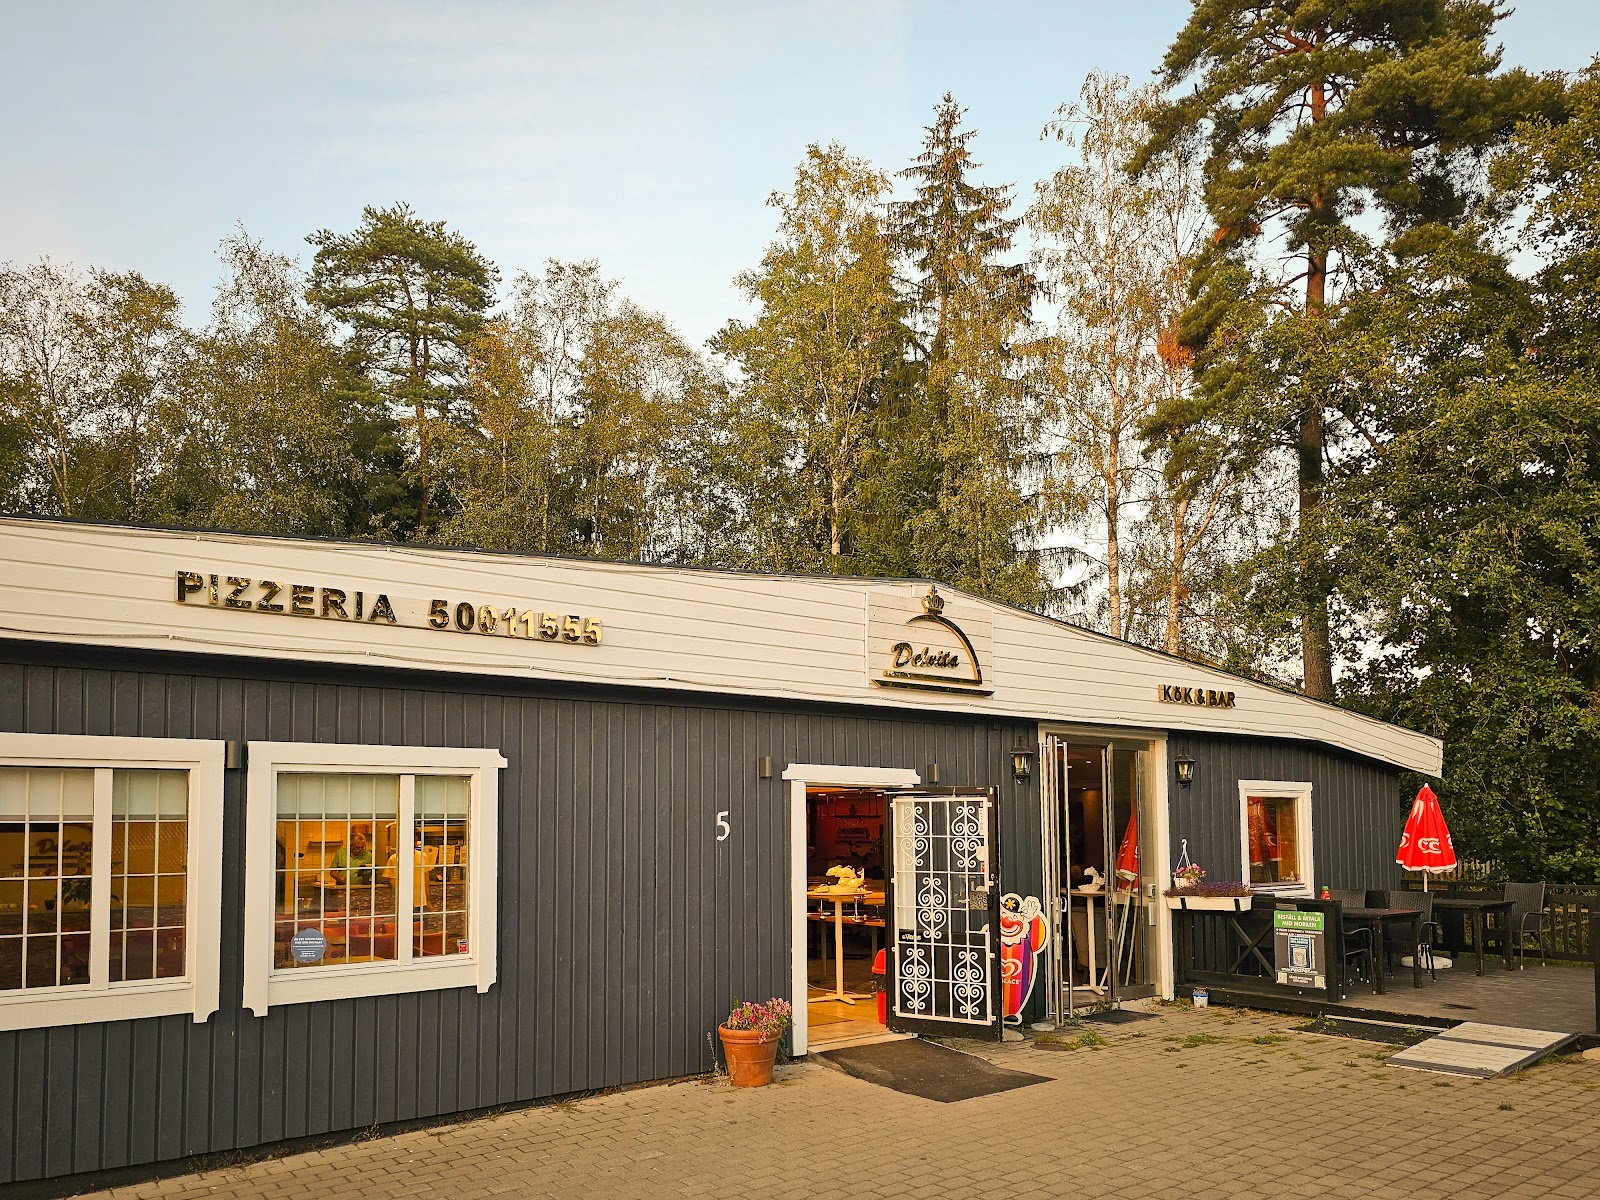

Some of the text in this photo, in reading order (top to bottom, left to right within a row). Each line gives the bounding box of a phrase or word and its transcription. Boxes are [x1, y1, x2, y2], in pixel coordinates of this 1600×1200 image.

[176, 570, 603, 646] PIZZERIA 50011555
[891, 642, 960, 669] Delvita
[1194, 688, 1206, 705] &
[1206, 689, 1236, 708] BAR
[716, 810, 731, 841] 5
